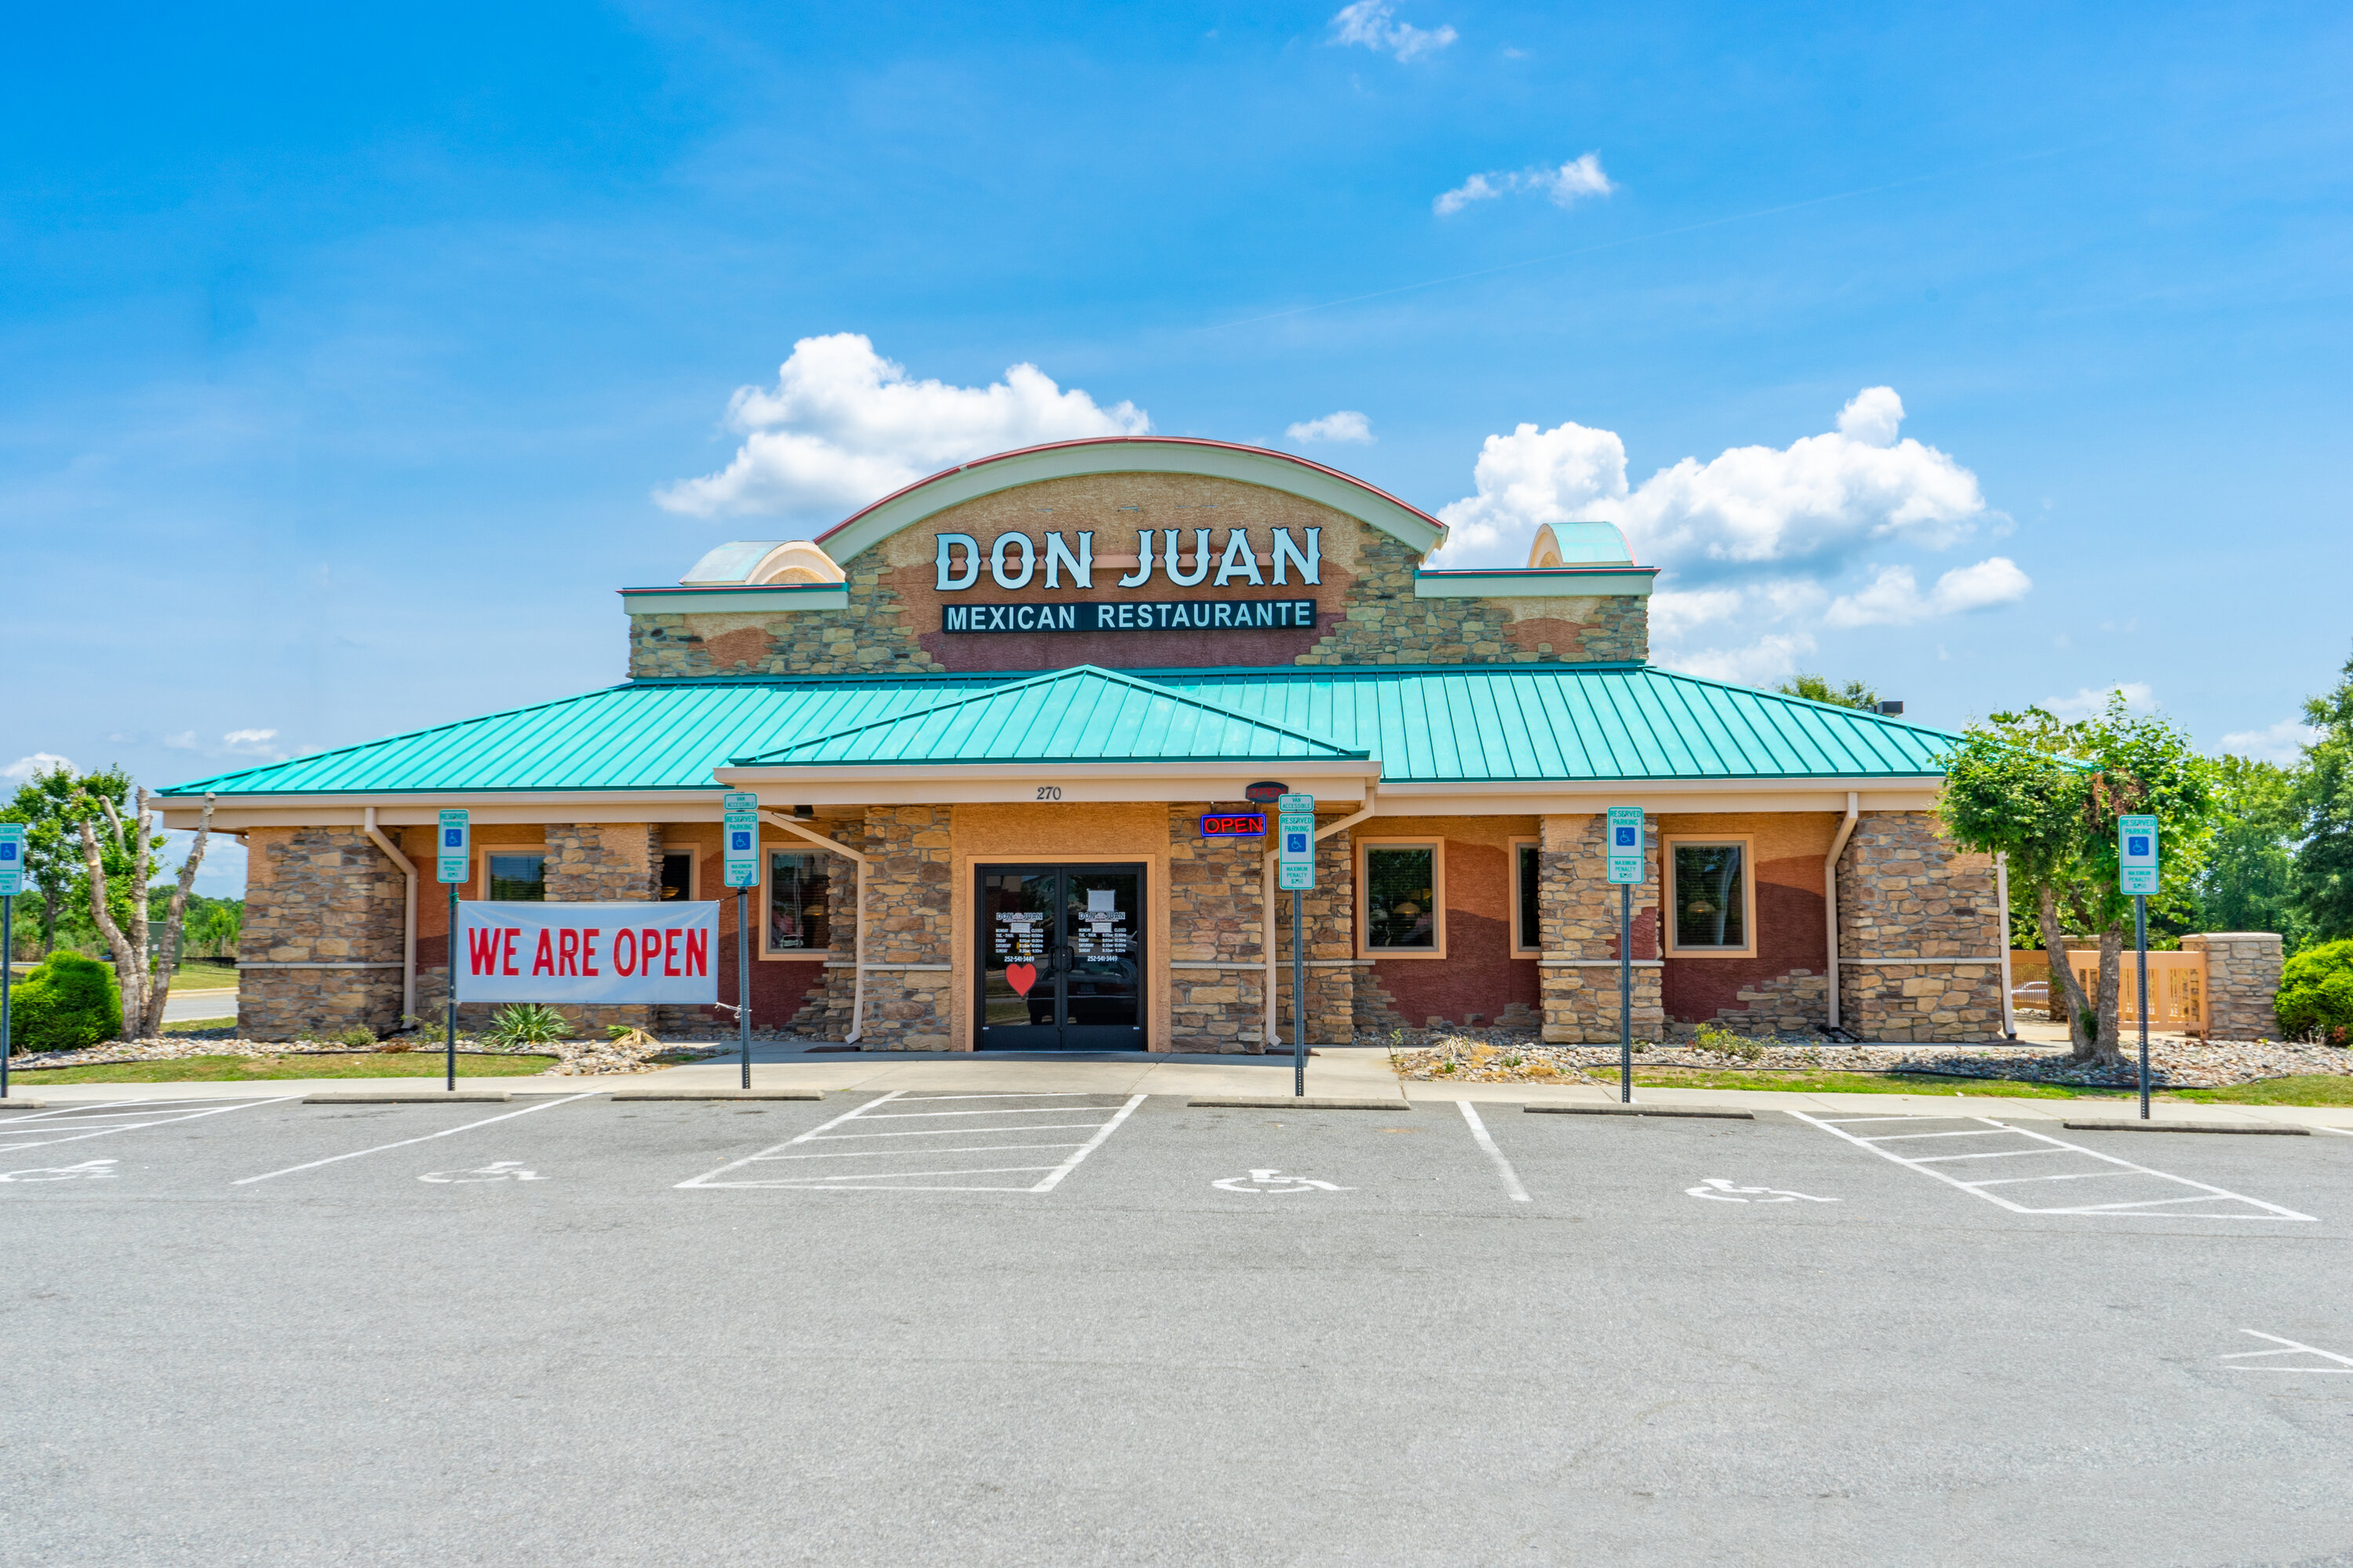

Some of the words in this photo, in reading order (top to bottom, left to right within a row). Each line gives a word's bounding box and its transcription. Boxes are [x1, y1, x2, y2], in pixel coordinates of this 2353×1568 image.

[934, 531, 1095, 591] DON
[1117, 527, 1323, 588] JUAN
[948, 606, 1075, 630] MEXICAN
[1098, 602, 1311, 628] RESTAURANTE
[1037, 787, 1061, 800] 270
[1248, 788, 1286, 797] OPEN
[1204, 817, 1262, 833] OPEN
[468, 928, 521, 976] WE
[532, 929, 599, 976] ARE
[613, 928, 708, 977] OPEN
